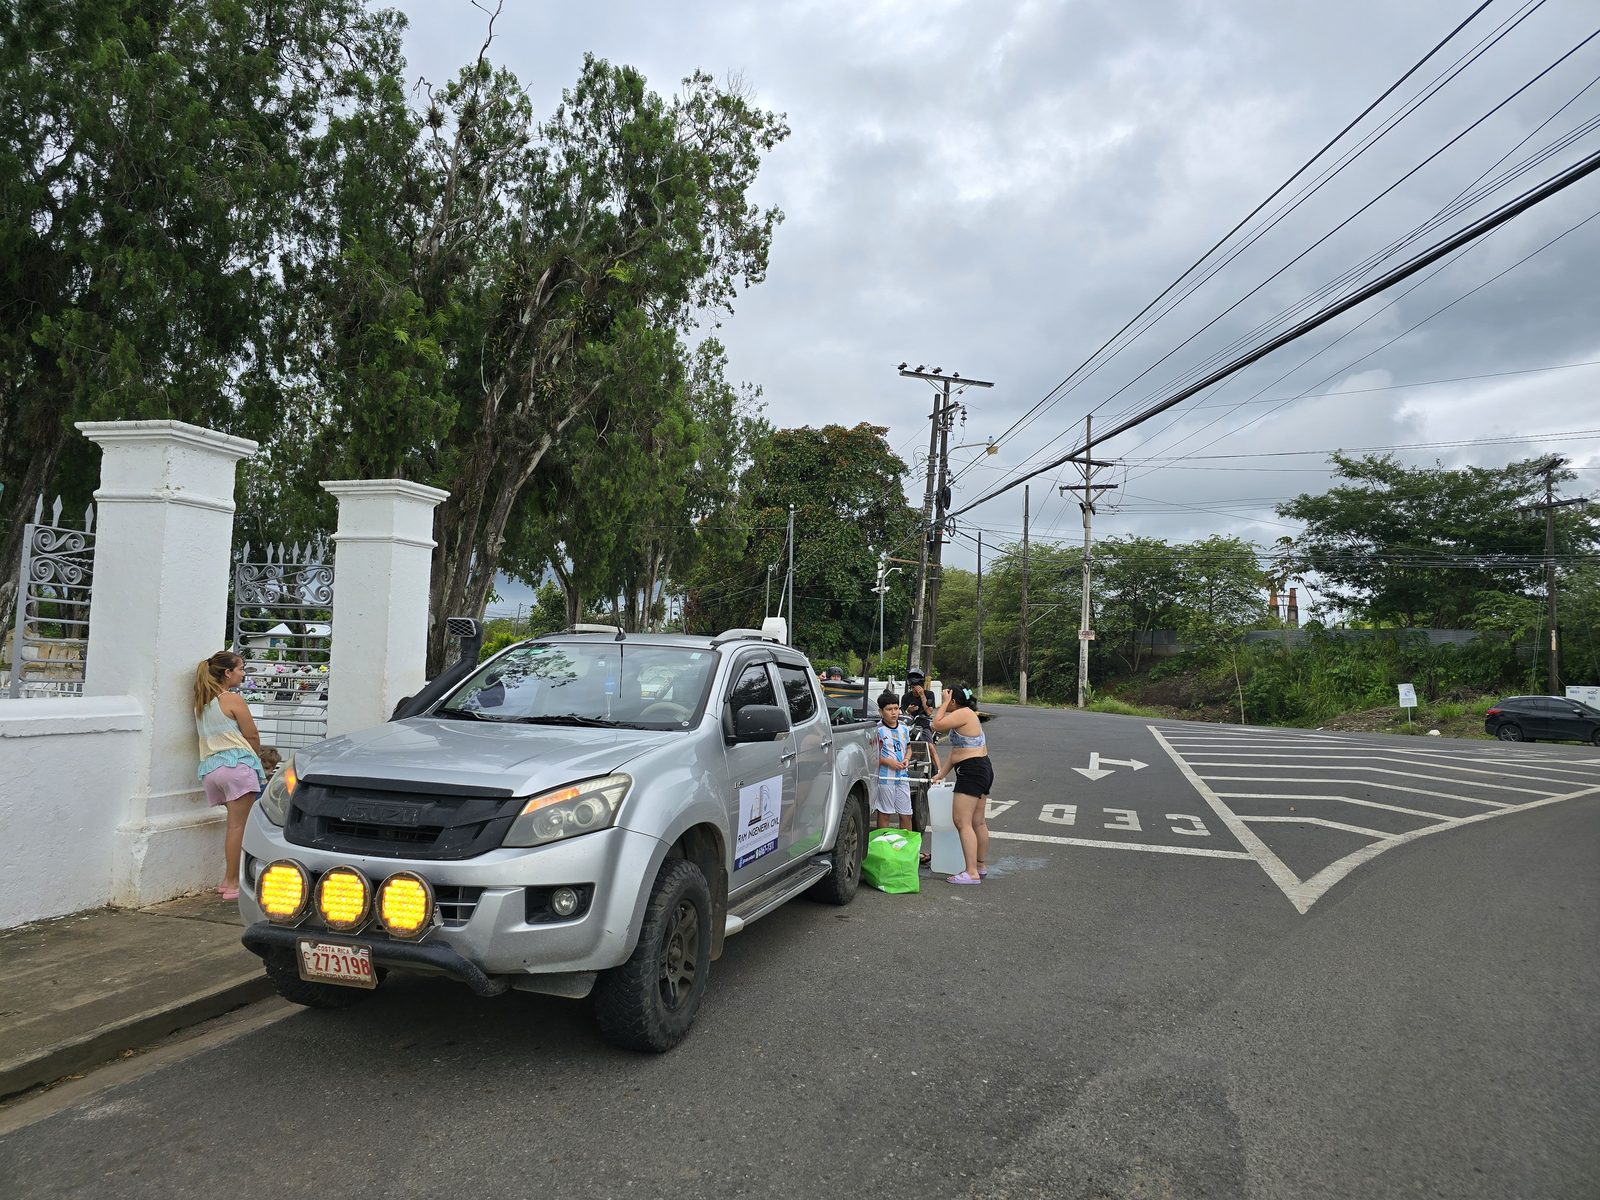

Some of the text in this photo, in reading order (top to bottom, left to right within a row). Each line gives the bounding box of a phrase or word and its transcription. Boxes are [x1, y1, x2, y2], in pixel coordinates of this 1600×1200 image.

[893, 742, 902, 752] 10
[737, 832, 748, 843] RAM
[317, 945, 335, 953] COSTA
[312, 952, 371, 976] 273198
